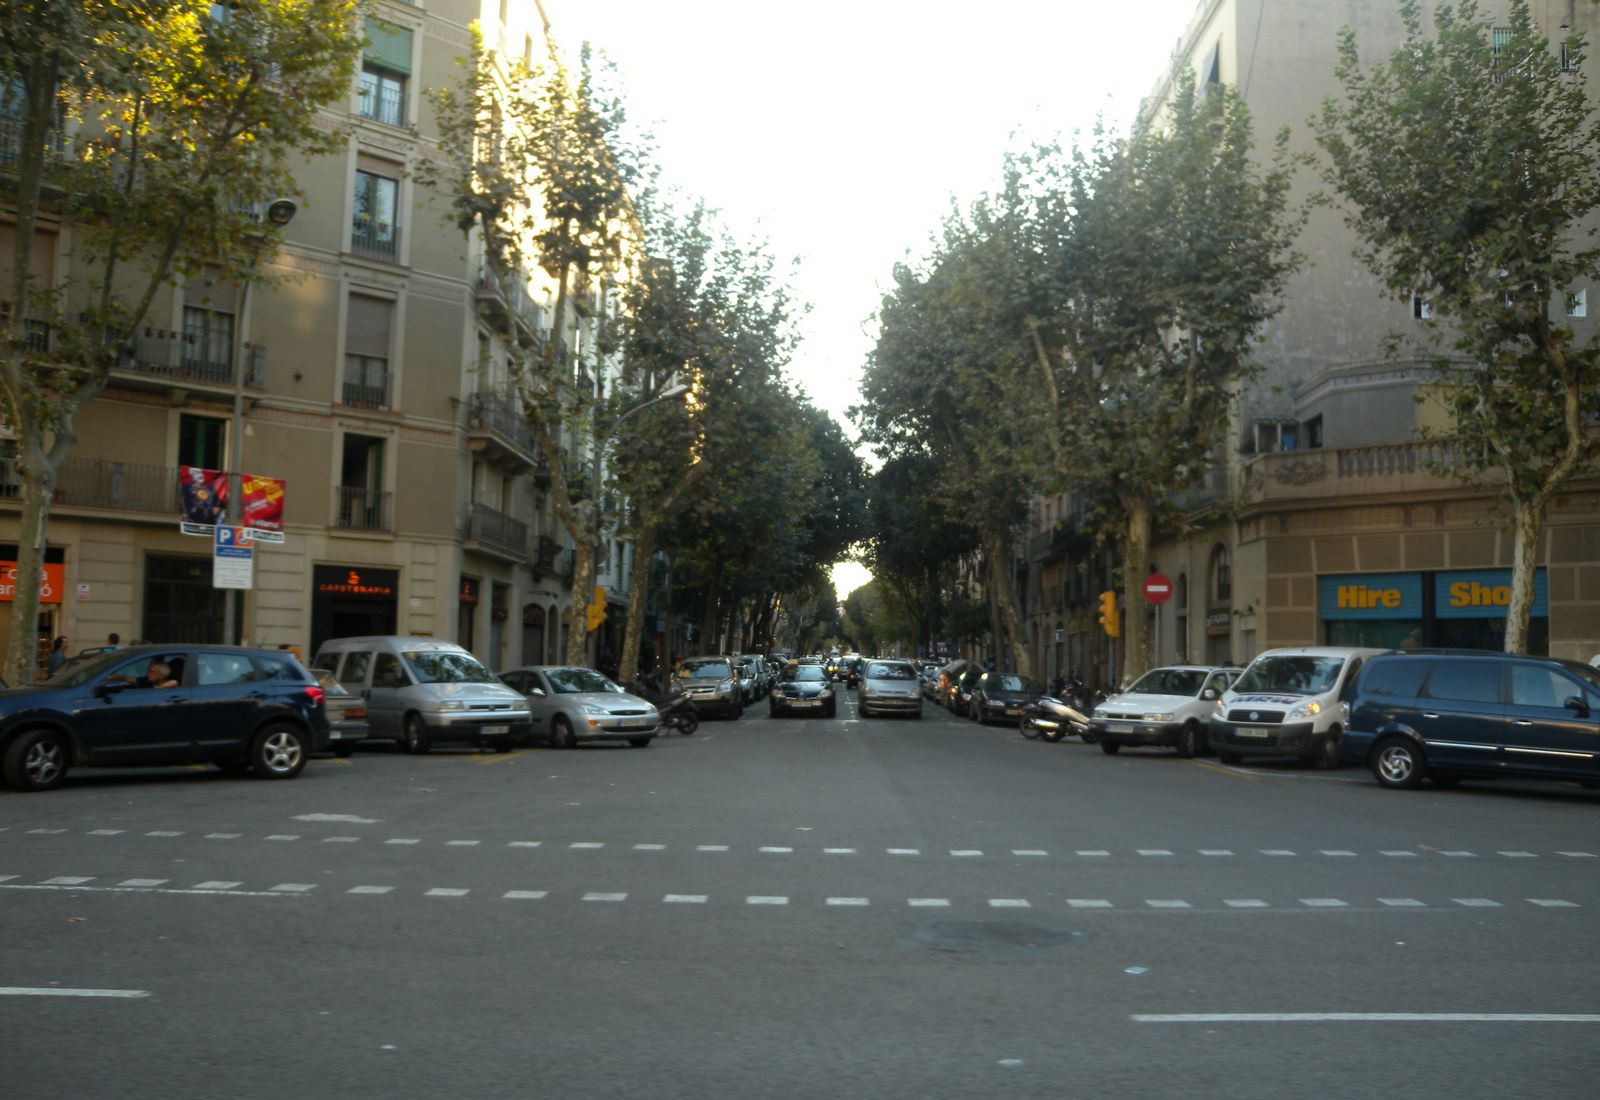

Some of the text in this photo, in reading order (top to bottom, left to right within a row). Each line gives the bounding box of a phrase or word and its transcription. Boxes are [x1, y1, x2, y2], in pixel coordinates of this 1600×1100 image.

[220, 529, 231, 543] P
[1337, 582, 1534, 608] Hire Sho
